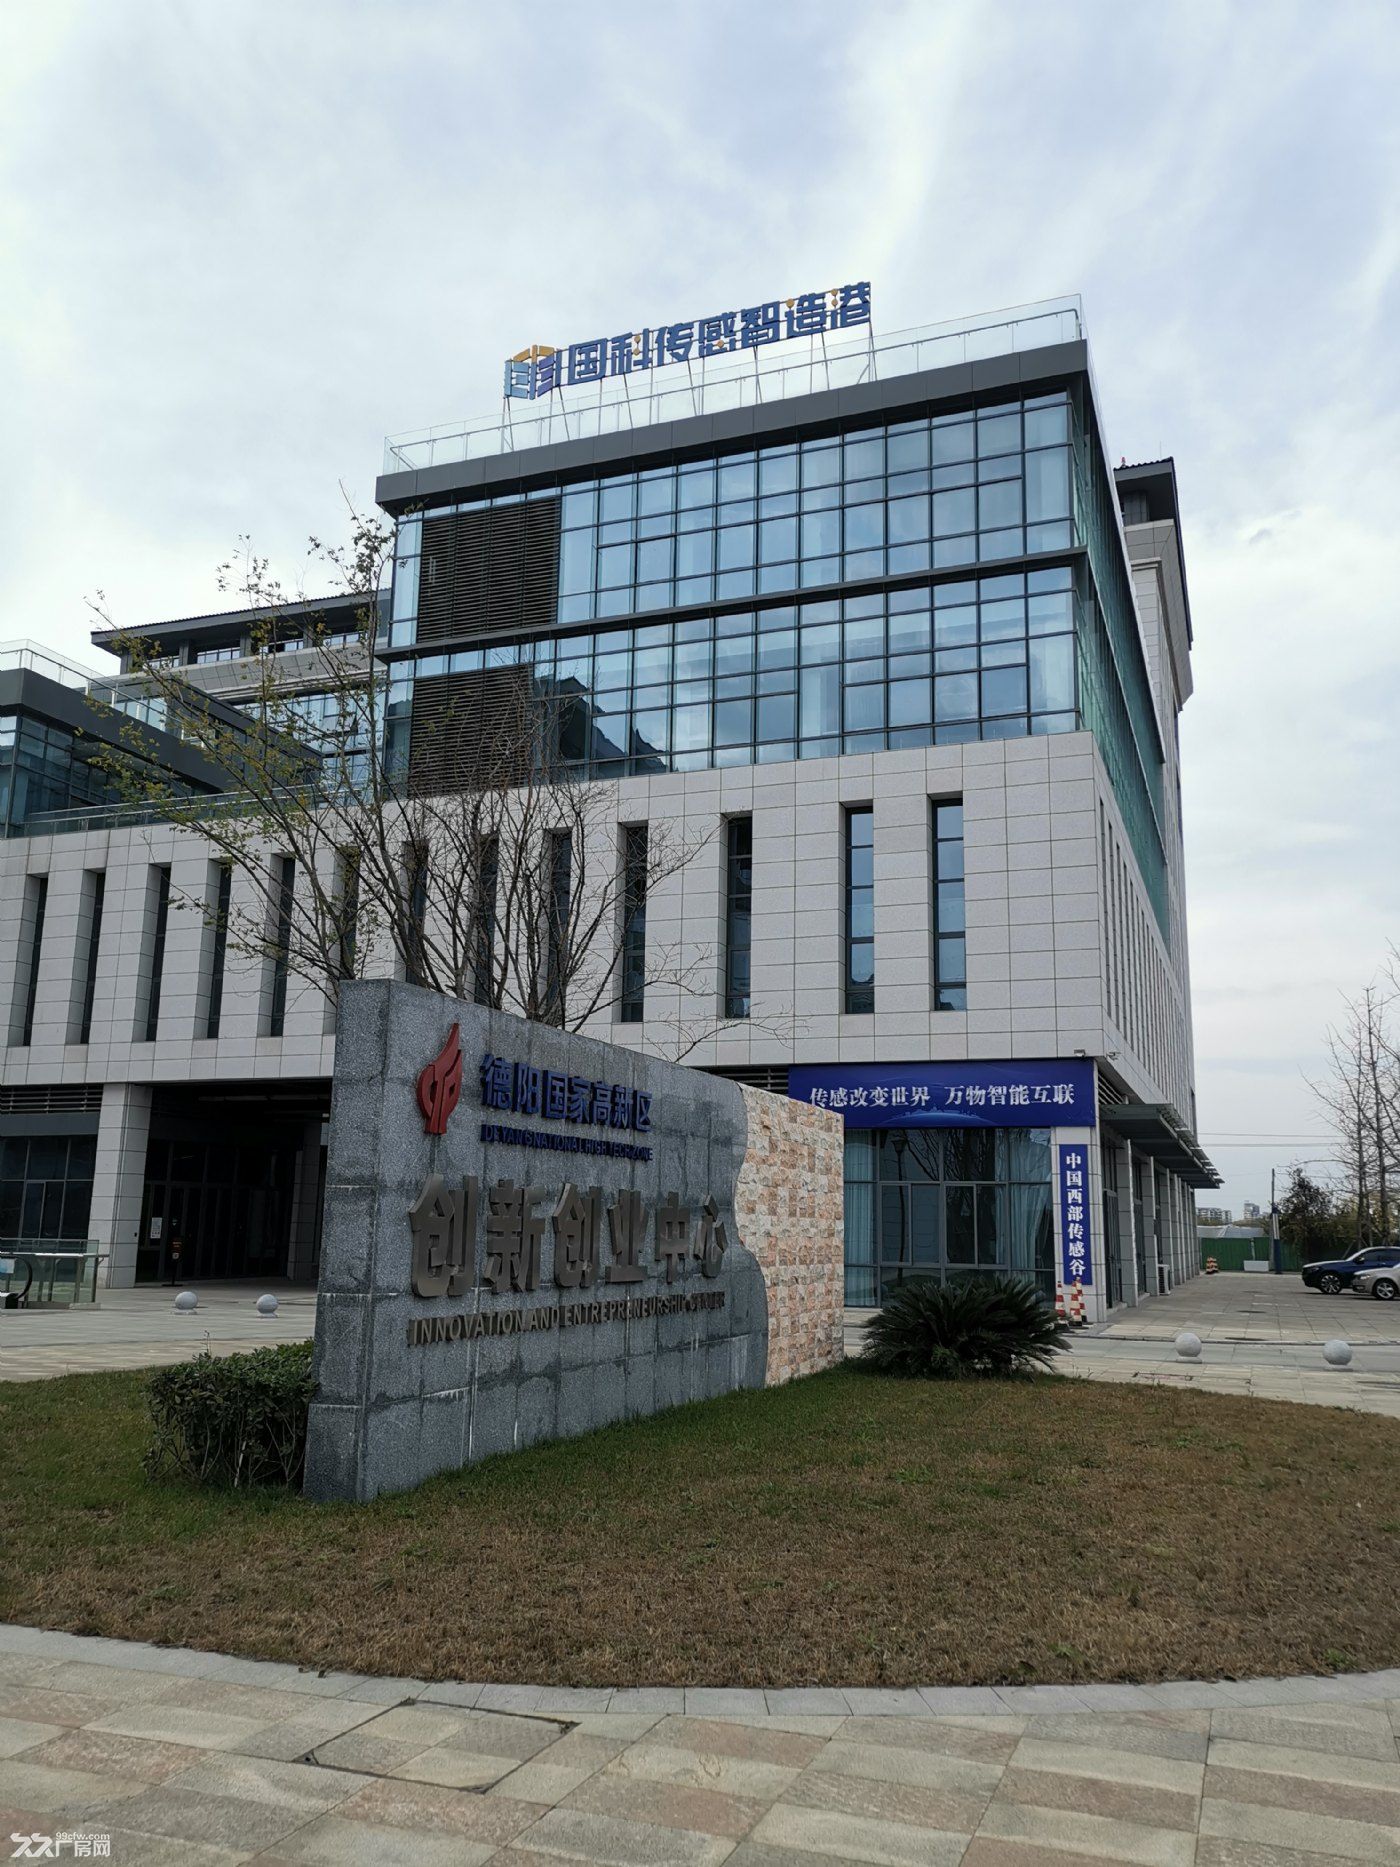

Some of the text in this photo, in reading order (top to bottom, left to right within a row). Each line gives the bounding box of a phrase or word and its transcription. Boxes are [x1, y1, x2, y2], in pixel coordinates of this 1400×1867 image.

[567, 281, 871, 386] 国科传感智造港
[480, 1054, 653, 1132] 德阳国家高新区
[810, 1083, 1075, 1108] 传感改变世界 万物智能互联
[533, 1131, 583, 1153] NATIONAL
[584, 1139, 607, 1155] HIGH
[408, 1173, 728, 1297] 创新创业中心
[1065, 1152, 1086, 1276] 中国西部传感谷
[408, 1309, 523, 1345] INNOVATION
[528, 1306, 560, 1331] AND
[561, 1294, 686, 1327] ENTREPRENEURSHIP
